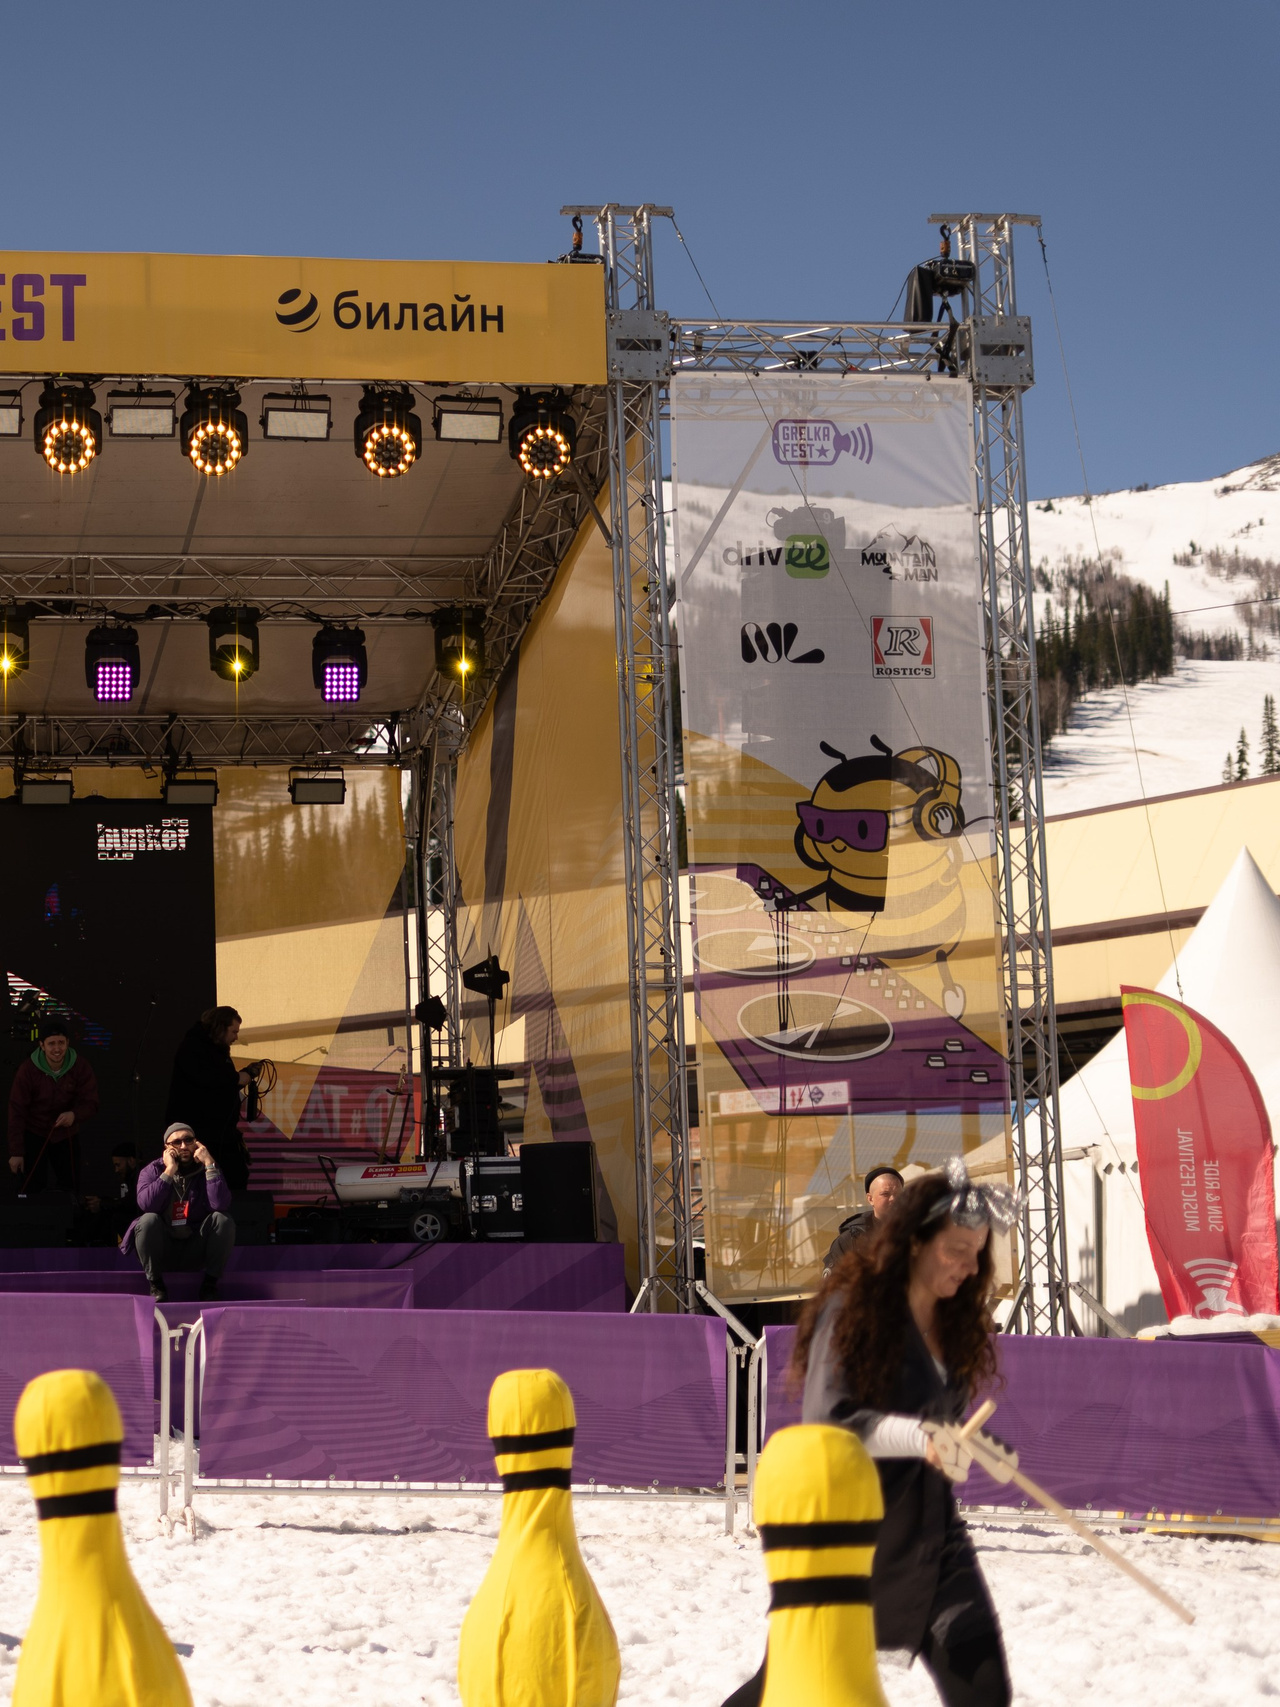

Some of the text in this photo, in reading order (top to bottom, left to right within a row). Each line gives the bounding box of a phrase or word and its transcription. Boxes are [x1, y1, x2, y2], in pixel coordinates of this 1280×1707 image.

[332, 288, 505, 334] билайн
[782, 425, 831, 442] GRELKA
[782, 443, 815, 459] FEST
[904, 567, 939, 582] MAN
[875, 667, 932, 677] ROSTIC'S
